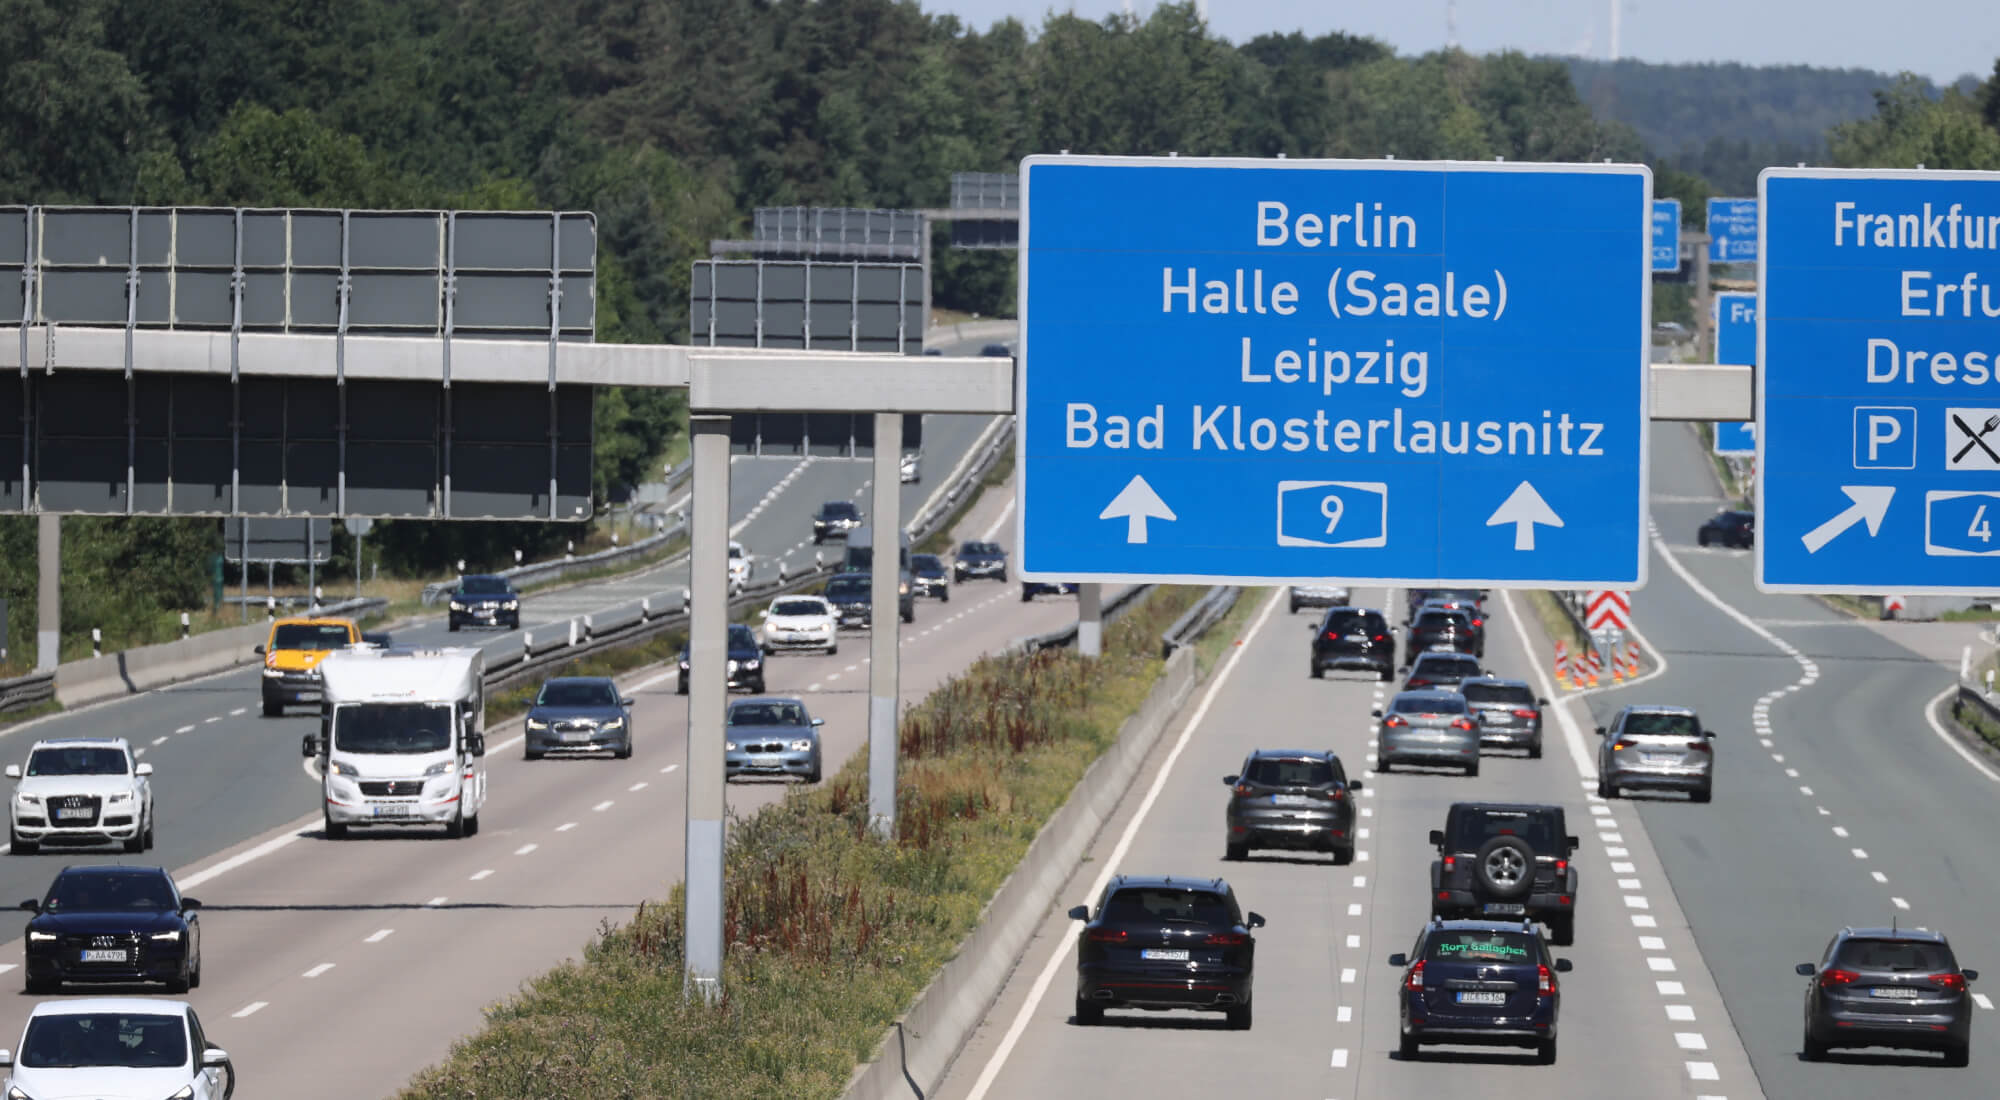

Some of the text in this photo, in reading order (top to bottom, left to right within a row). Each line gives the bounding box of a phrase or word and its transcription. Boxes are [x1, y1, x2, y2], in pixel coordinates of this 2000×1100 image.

[1257, 201, 1416, 248] Berlin
[1163, 267, 1507, 321] Halle (Saale)
[1731, 303, 1756, 322] Fr
[1241, 337, 1428, 398] Leipzig
[1867, 338, 2000, 385] Dres
[1066, 402, 1604, 456] Bad Klosterlausnitz
[1869, 415, 1901, 461] P
[1321, 495, 1344, 534] 9
[1968, 504, 1992, 542] 4
[1441, 942, 1526, 955] Rory Gallagher
